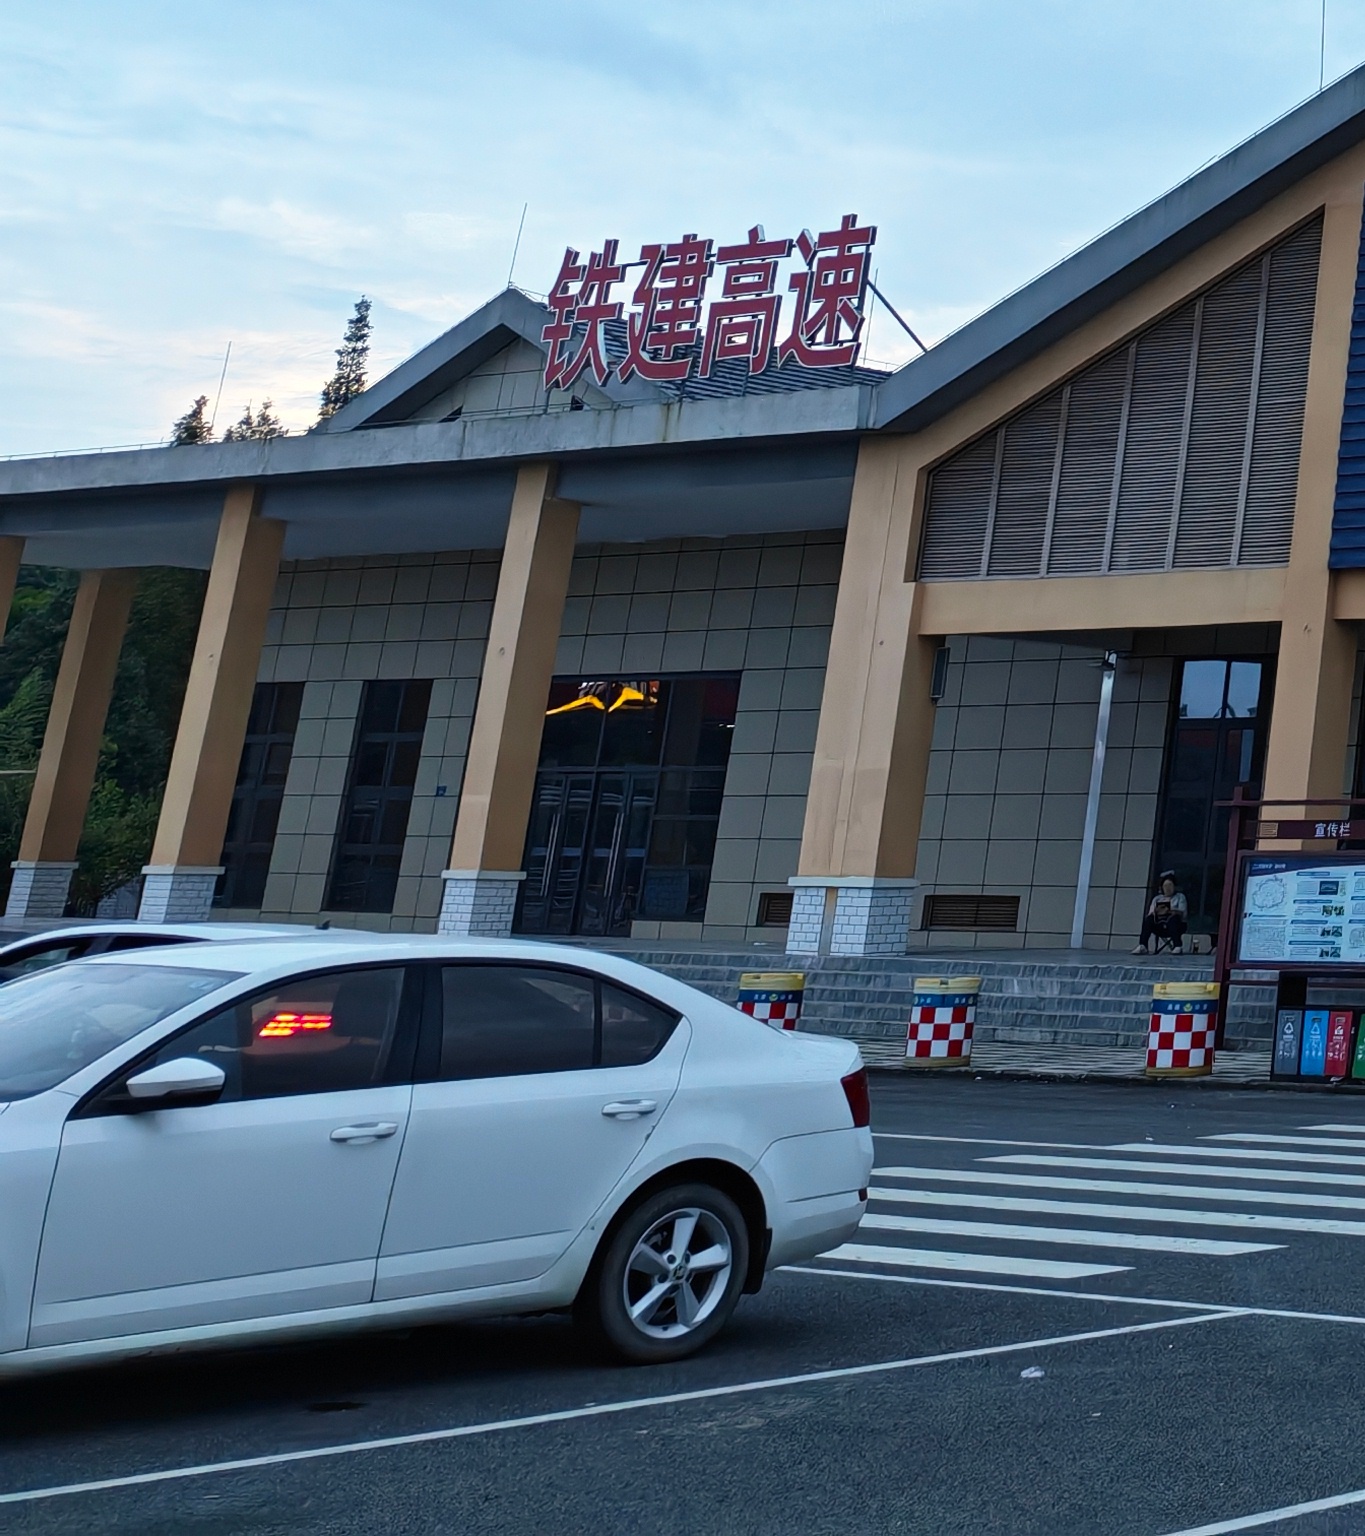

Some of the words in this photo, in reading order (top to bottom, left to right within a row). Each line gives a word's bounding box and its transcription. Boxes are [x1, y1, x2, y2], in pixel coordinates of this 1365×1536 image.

[541, 214, 878, 392] 铁建高速
[1314, 822, 1351, 837] 宣传栏
